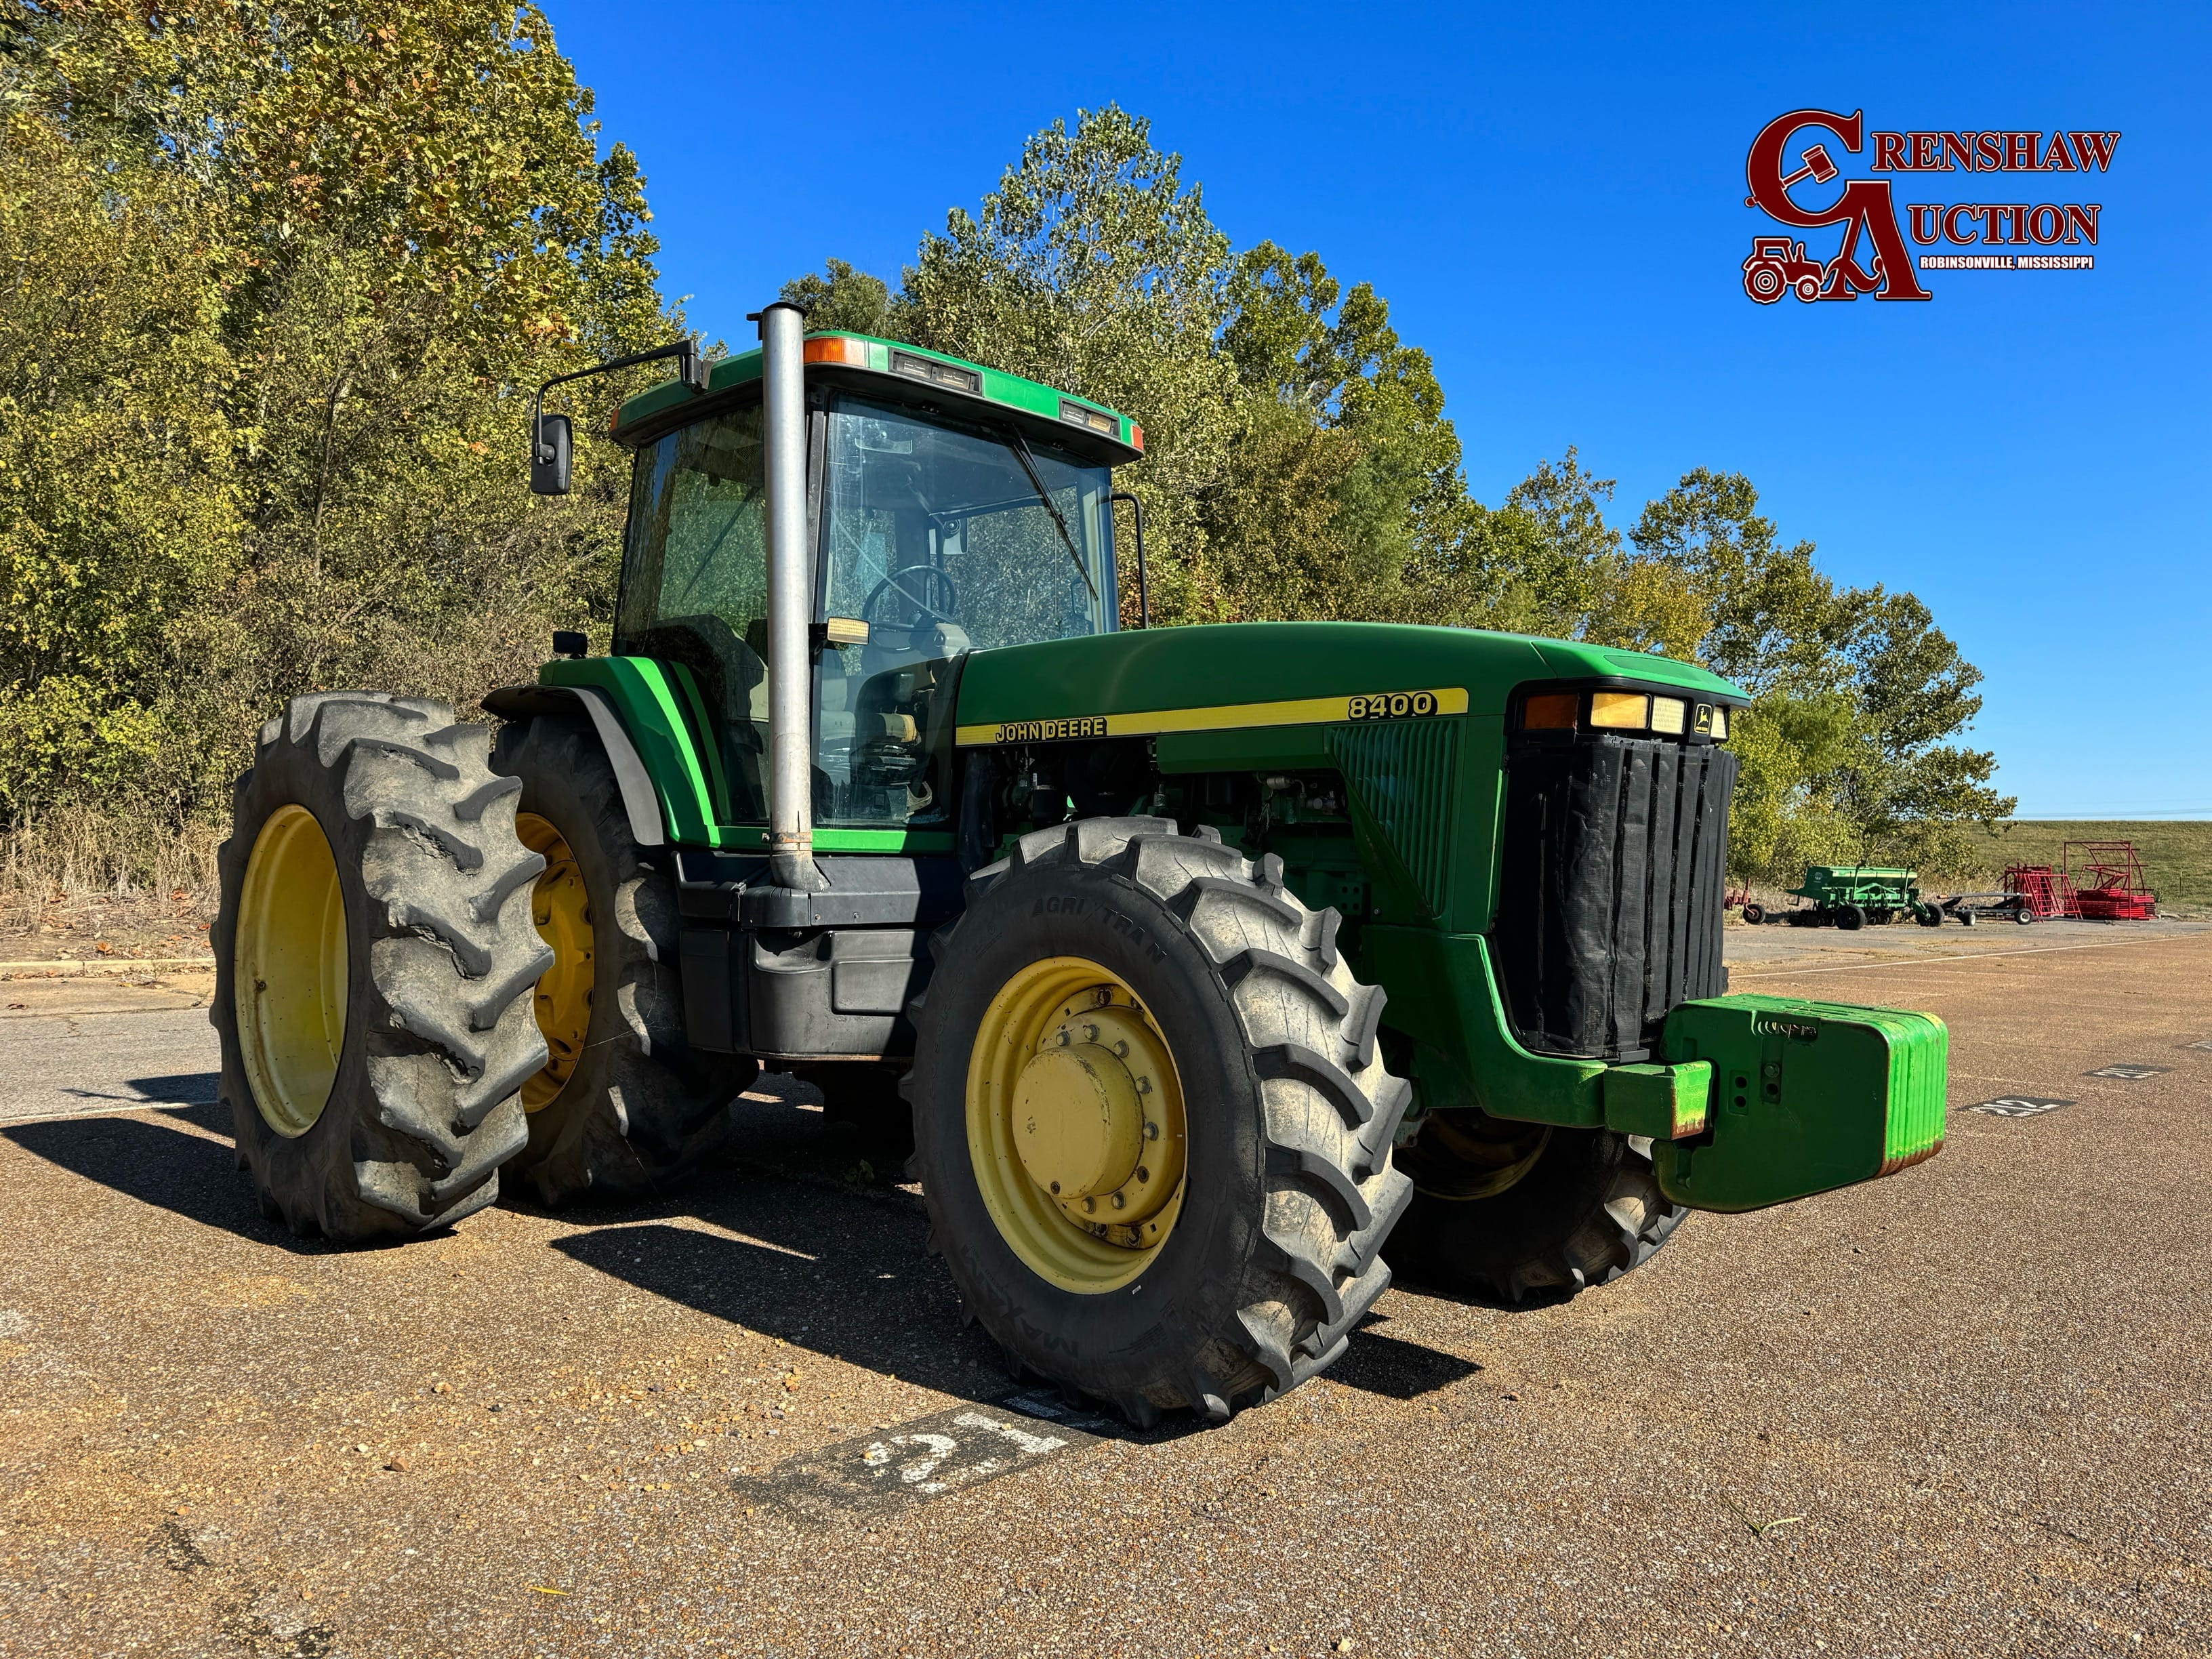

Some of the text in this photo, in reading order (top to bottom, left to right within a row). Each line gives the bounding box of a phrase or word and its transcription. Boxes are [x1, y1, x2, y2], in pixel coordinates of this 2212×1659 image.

[1349, 691, 1437, 720] 8400
[996, 717, 1107, 743] JOHN DEERE
